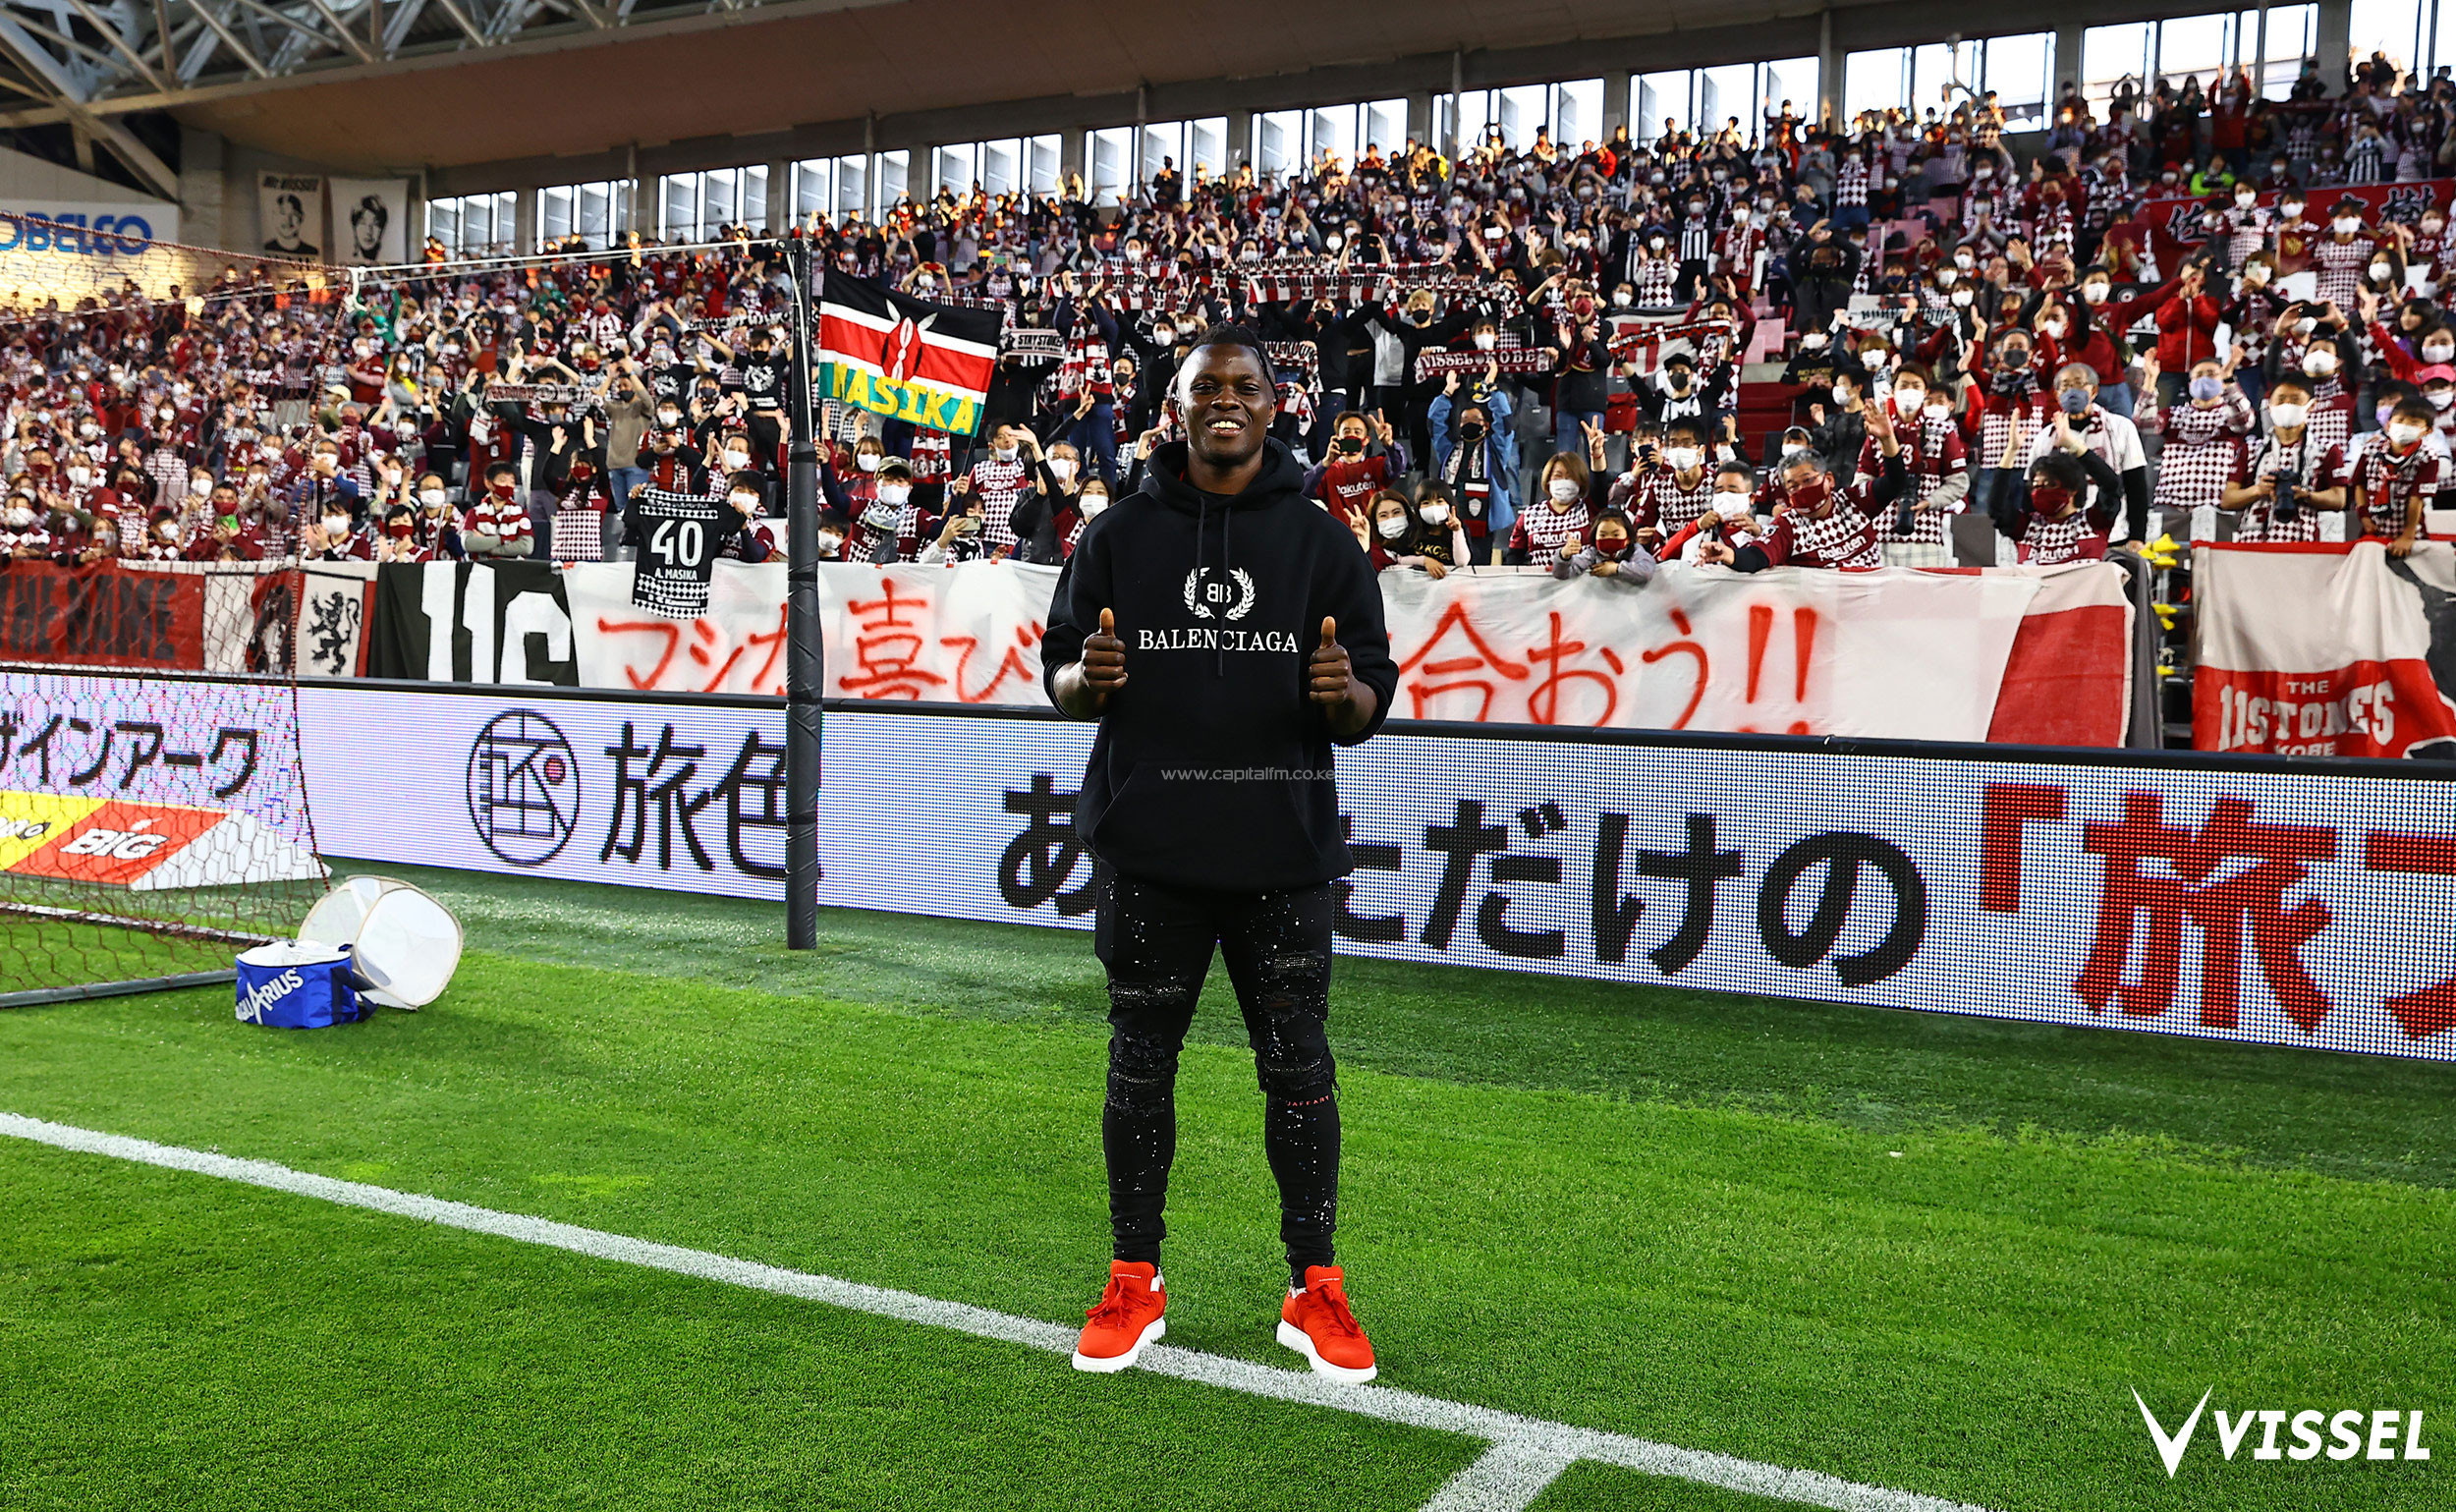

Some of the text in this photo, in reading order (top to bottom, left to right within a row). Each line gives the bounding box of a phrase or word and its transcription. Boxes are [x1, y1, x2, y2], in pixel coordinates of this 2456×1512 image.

[1278, 276, 1313, 288] SHALL
[1421, 350, 1536, 368] VISSEL KOBE
[832, 360, 974, 434] MASIKA
[650, 520, 704, 568] 40
[1817, 534, 1868, 562] Rakuten
[665, 568, 698, 581] MASIKA
[1138, 629, 1300, 654] BALENCIAGA
[2286, 680, 2329, 695] THE
[2275, 741, 2336, 756] KOBE
[601, 721, 823, 882] 旅色
[60, 827, 170, 860] BIG
